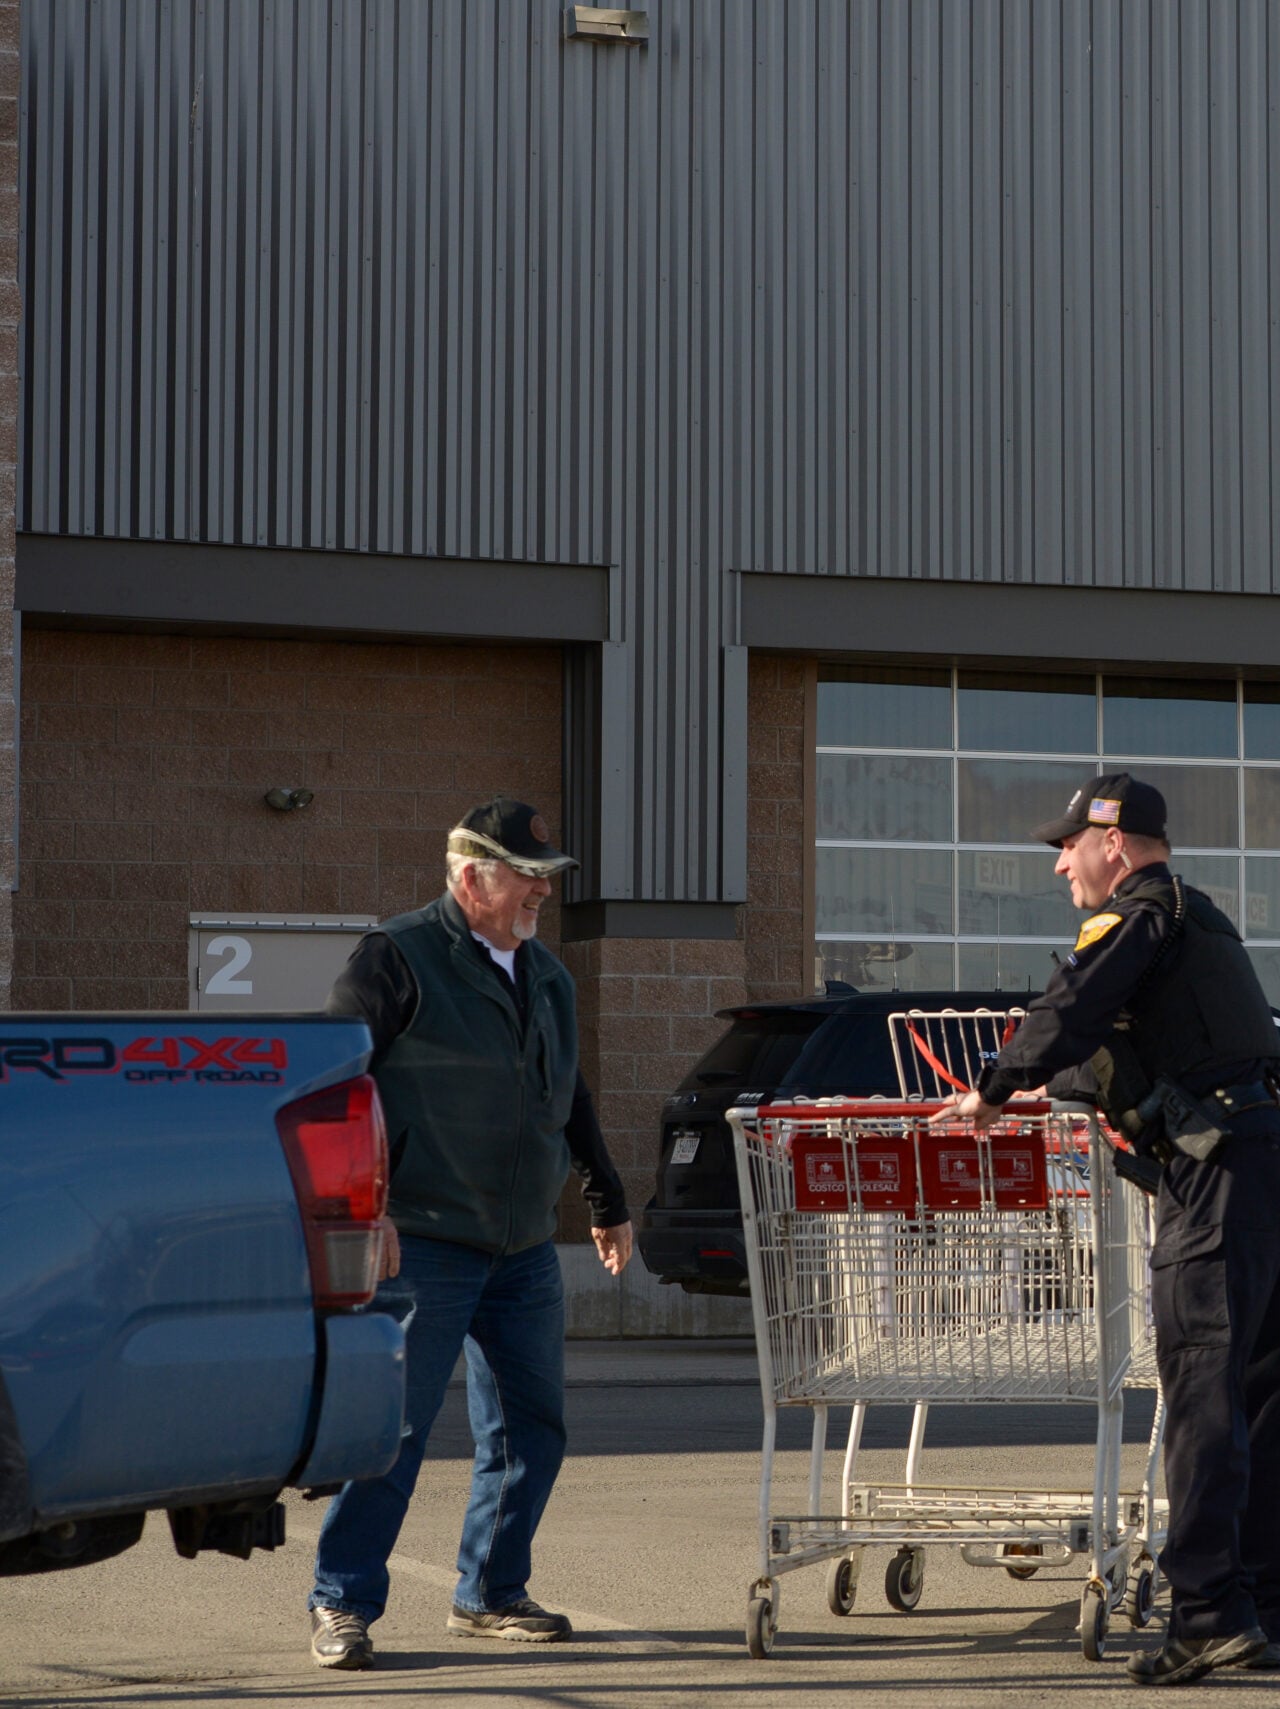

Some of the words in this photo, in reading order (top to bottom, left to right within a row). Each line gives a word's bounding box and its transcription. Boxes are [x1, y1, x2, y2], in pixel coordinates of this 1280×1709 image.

[979, 855, 1016, 887] EXIT
[205, 935, 253, 995] 2
[121, 1036, 288, 1070] 4X4
[124, 1069, 190, 1085] OFF
[194, 1070, 285, 1086] ROAD
[809, 1183, 845, 1192] COSTCO
